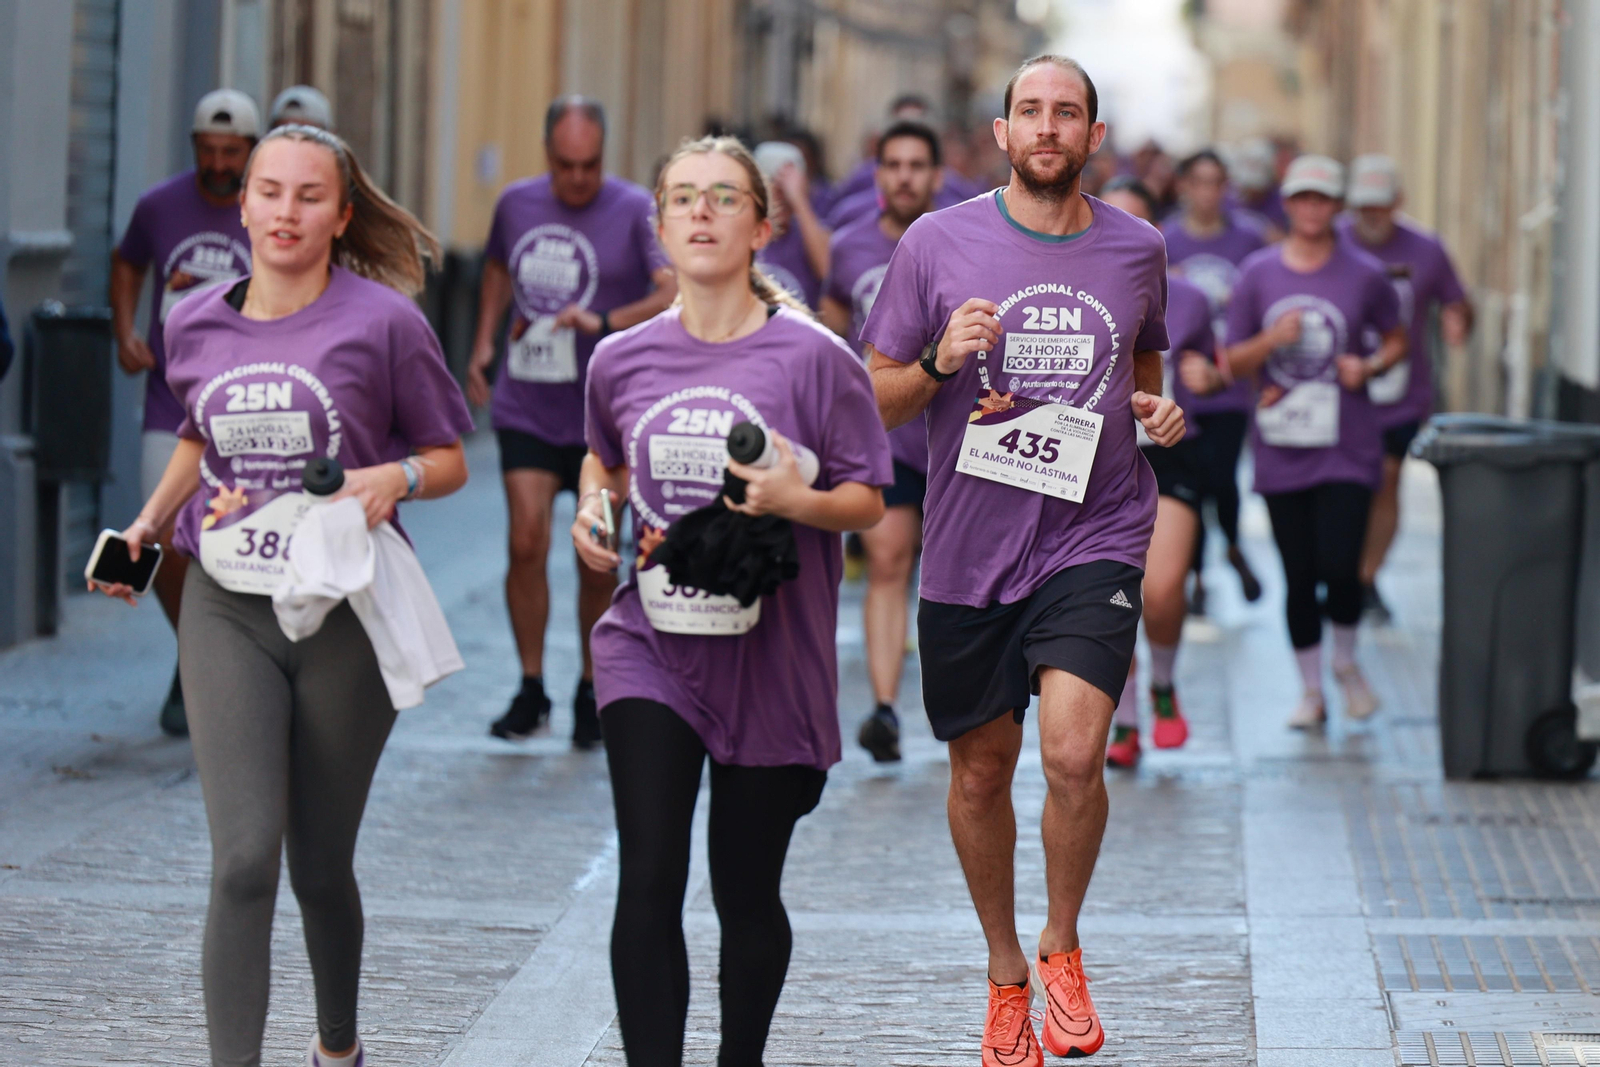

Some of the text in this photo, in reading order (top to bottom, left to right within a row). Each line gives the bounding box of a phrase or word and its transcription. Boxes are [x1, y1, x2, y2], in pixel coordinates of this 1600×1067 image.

[992, 283, 1074, 322] TERNACIONAL
[1077, 290, 1117, 333] CONTRA
[1111, 333, 1120, 352] LA
[1022, 306, 1082, 331] 25N
[1018, 344, 1079, 356] 24 HORAS
[1008, 357, 1087, 370] 900 21 21 30
[1022, 380, 1058, 389] Ayuntamiento
[225, 381, 293, 413] 25N
[667, 407, 735, 438] 25N
[1057, 413, 1096, 430] CARRERA
[997, 428, 1062, 464] 435
[969, 447, 980, 458] EL
[982, 451, 1014, 467] AMOR
[1016, 459, 1033, 471] NO
[1034, 465, 1079, 484] LASTIMA
[215, 559, 285, 575] TOLERANCIA
[1109, 598, 1133, 609] adidas
